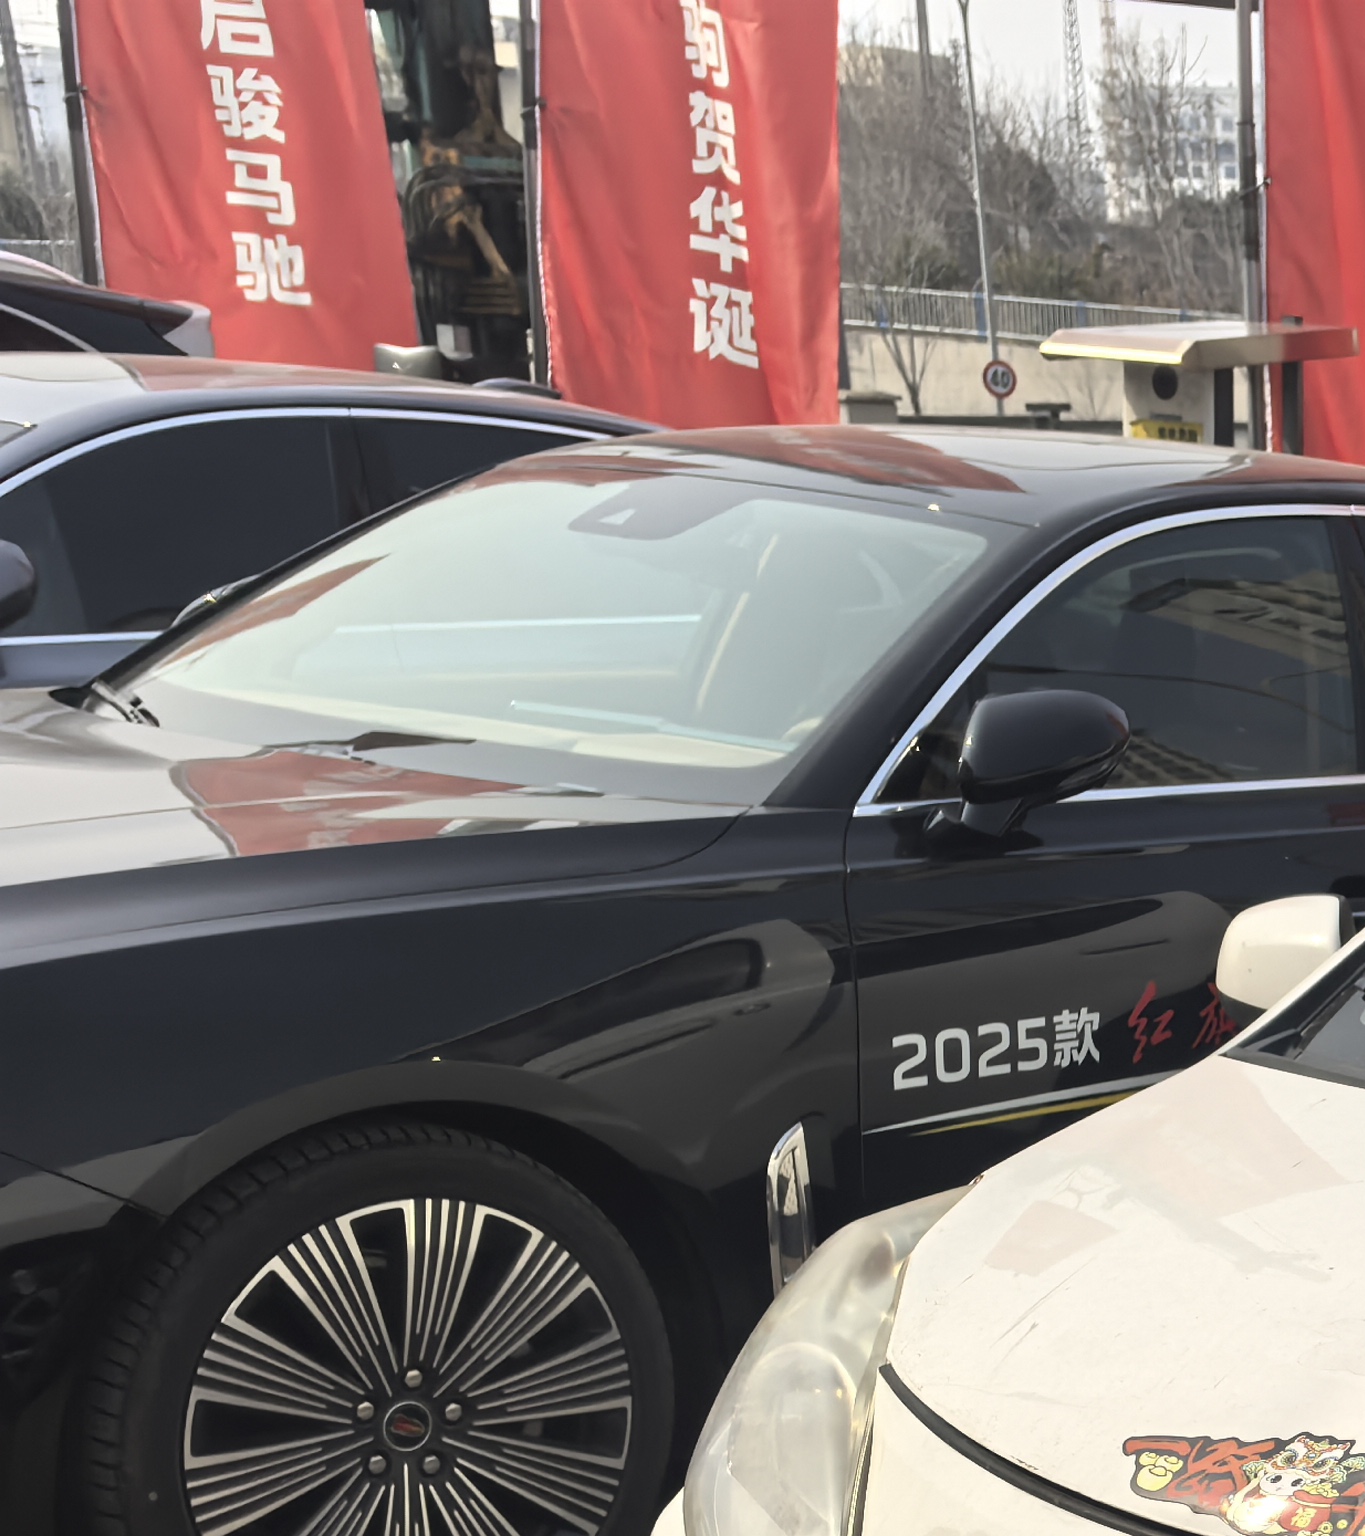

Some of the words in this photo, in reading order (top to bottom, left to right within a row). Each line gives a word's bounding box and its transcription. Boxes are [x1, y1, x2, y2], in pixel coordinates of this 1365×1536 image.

[201, 0, 312, 306] 启骏马驰
[679, 0, 760, 369] 驹贺华诞
[892, 1006, 1101, 1091] 2025款
